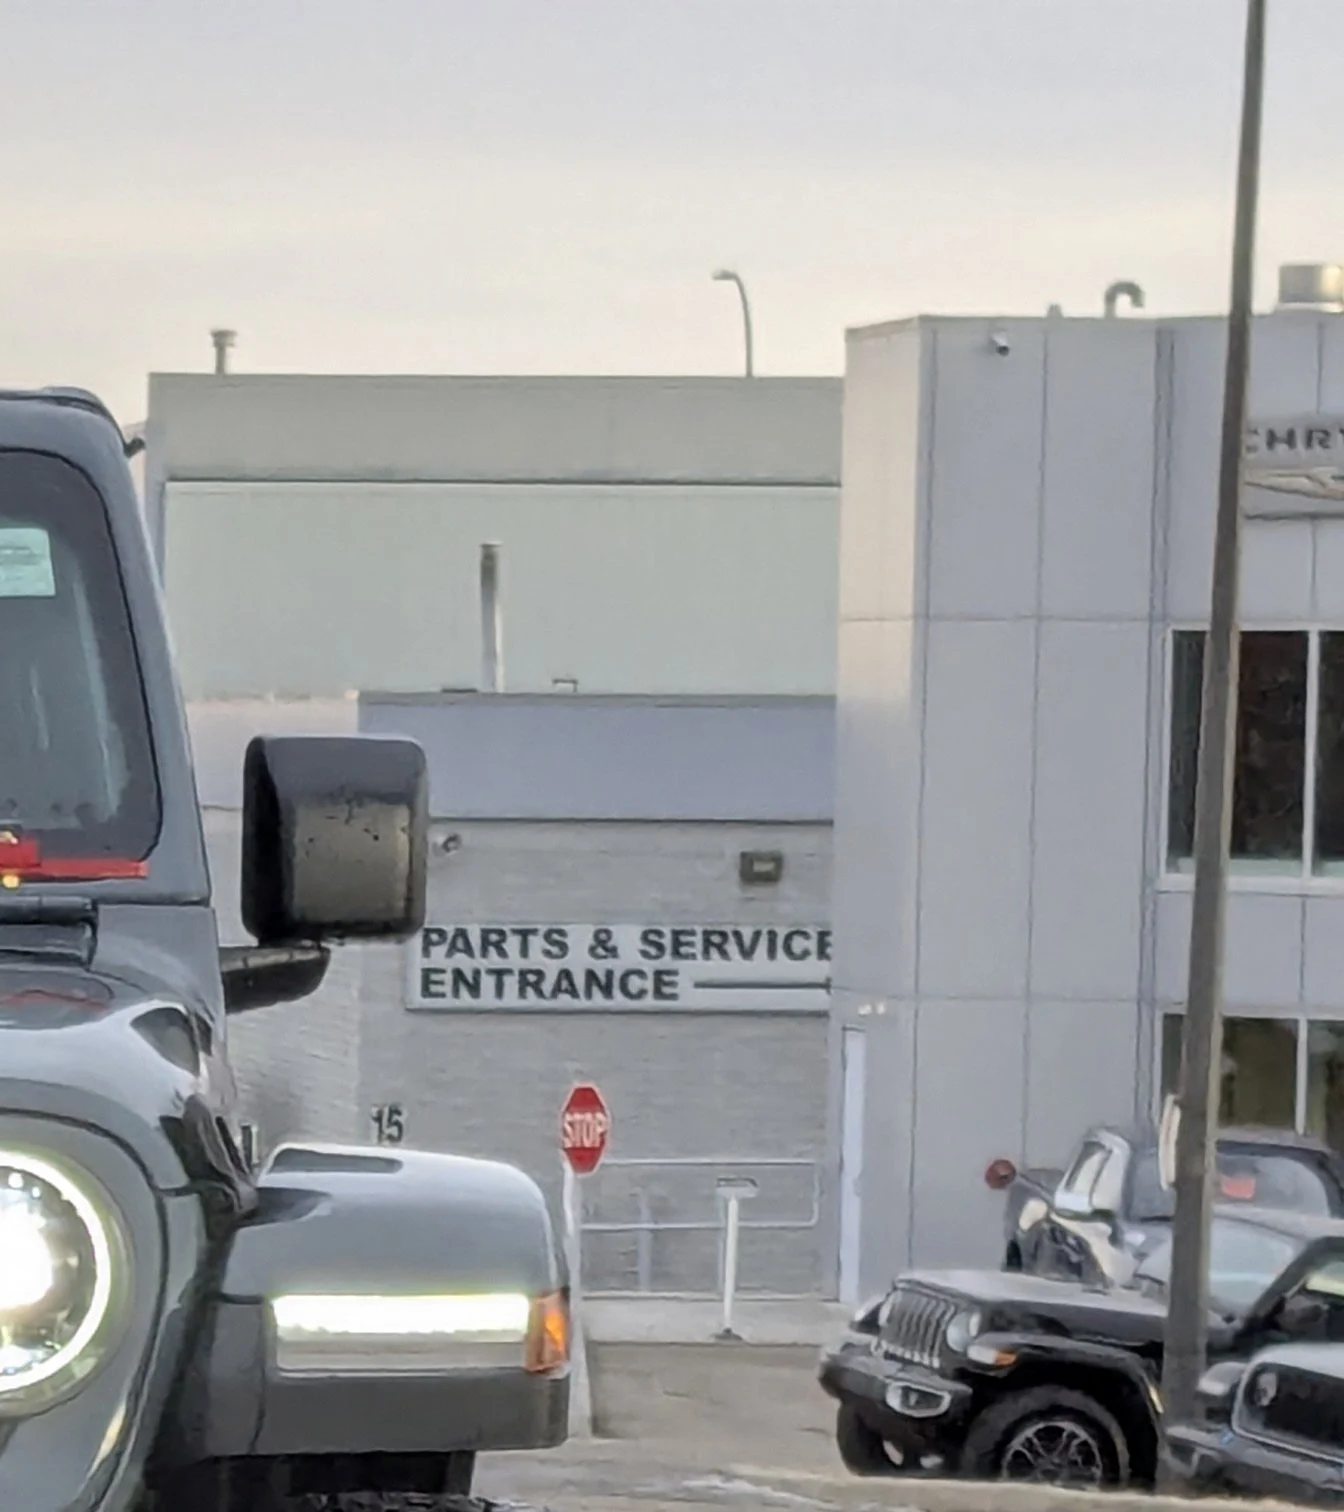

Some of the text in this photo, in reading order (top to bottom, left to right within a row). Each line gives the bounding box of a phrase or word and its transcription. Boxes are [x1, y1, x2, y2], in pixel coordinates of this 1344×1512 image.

[1244, 427, 1344, 453] CHR
[421, 927, 569, 960] PARTS
[587, 927, 620, 961] &
[420, 967, 679, 1001] ENTRANCE
[372, 1103, 404, 1144] 15
[563, 1112, 607, 1148] STOP
